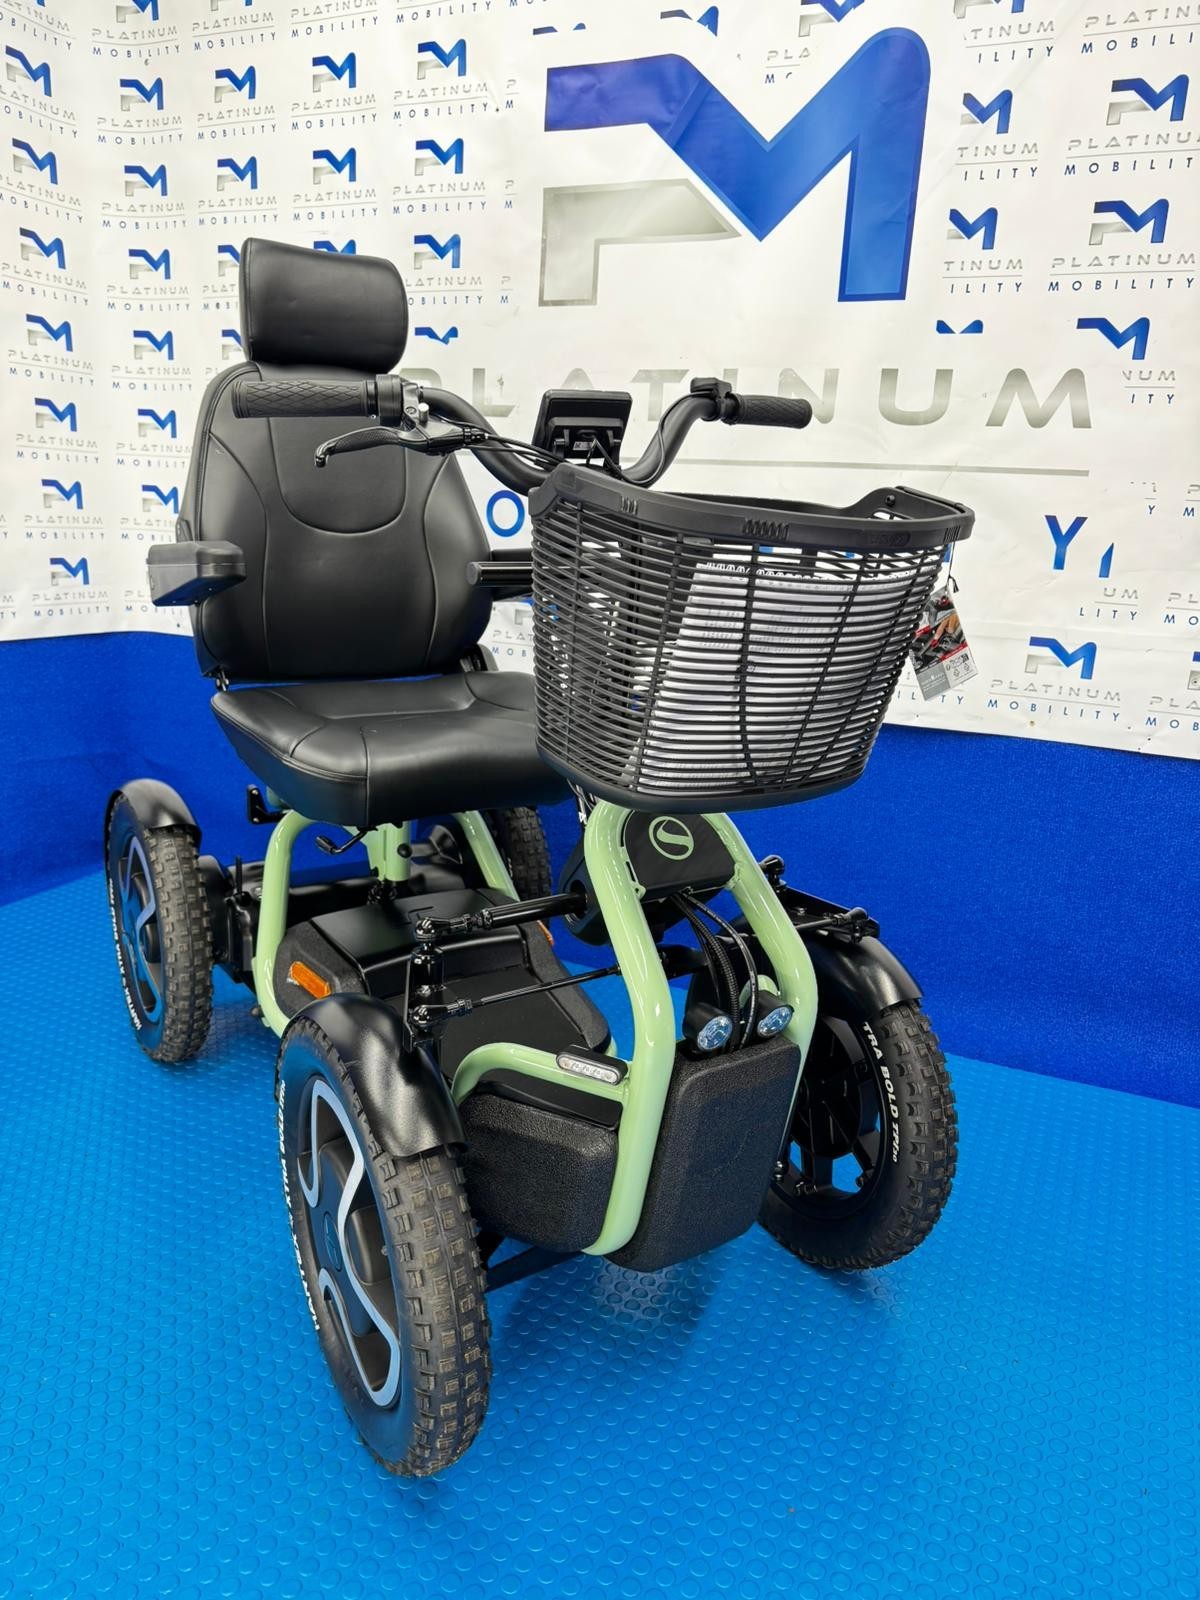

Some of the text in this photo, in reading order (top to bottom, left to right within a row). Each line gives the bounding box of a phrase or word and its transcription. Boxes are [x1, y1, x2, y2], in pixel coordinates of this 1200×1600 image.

[396, 0, 491, 23] MOBILITY
[192, 11, 273, 32] PLATINUM
[291, 16, 378, 38] MOBILITY
[92, 25, 178, 41] PLATINUM
[194, 32, 276, 51] MOBILITY
[92, 43, 183, 60] MOBILITY
[394, 82, 487, 100] PLATINUM
[291, 93, 375, 112] PLATINUM
[197, 105, 275, 123] PLATINUM
[393, 102, 488, 120] MOBILITY
[97, 115, 182, 129] PLATINUM
[291, 113, 377, 131] MOBILITY
[198, 123, 276, 140] MOBILITY
[98, 133, 183, 148] MOBILITY
[292, 188, 376, 203] PLATINUM
[392, 181, 486, 196] PLATINUM
[101, 202, 185, 213] PLATINUM
[198, 196, 277, 209] PLATINUM
[392, 201, 486, 215] MOBILITY
[198, 214, 278, 226] MOBILITY
[292, 208, 378, 221] MOBILITY
[102, 220, 186, 231] MOBILITY
[1051, 252, 1196, 270] PLATINUM
[1, 262, 86, 290] PLATINUM
[1048, 275, 1198, 292] MOBILITY
[2, 280, 88, 306] MOBILITY
[106, 284, 188, 296] PLATINUM
[108, 301, 190, 312] MOBILITY
[8, 349, 93, 371] PLATINUM
[9, 367, 94, 386] MOBILITY
[112, 365, 191, 376] PLATINUM
[112, 381, 192, 391] MOBILITY
[16, 434, 97, 448] PLATINUM
[17, 450, 99, 464] MOBILITY
[24, 515, 103, 524] PLATINUM
[26, 532, 104, 540] MOBILITY
[32, 590, 108, 602] PLATINUM
[34, 606, 110, 616] MOBILITY
[989, 679, 1120, 703] PLATINUM
[987, 698, 1120, 722] MOBILITY
[880, 1066, 899, 1118] BOLD
